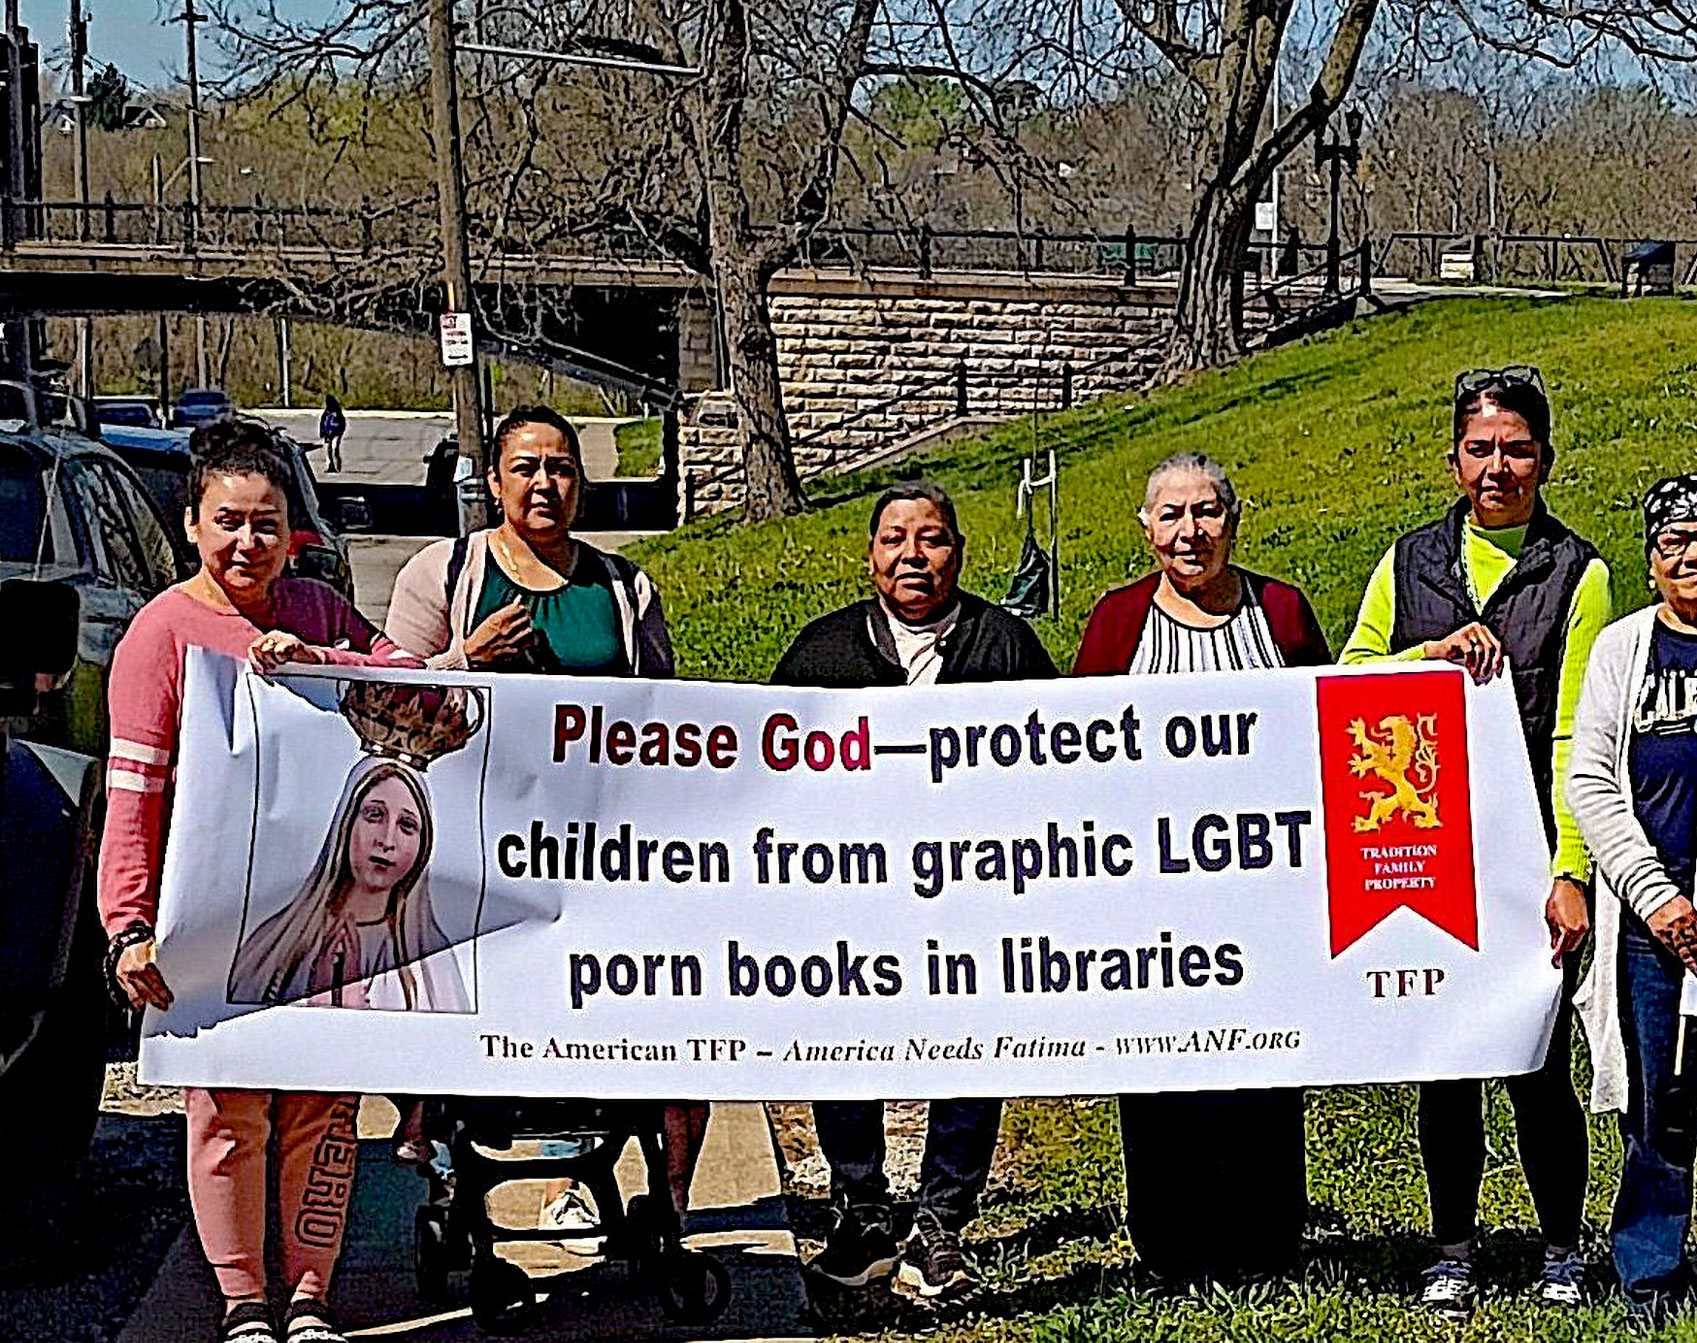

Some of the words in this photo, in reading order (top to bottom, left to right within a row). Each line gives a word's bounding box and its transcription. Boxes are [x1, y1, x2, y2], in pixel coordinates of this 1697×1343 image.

[553, 704, 737, 768] Please
[1166, 713, 1257, 758] our
[498, 821, 729, 883] children
[753, 827, 887, 883] from
[912, 821, 1132, 898] graphic
[1158, 811, 1311, 873] LGBT
[1360, 844, 1437, 859] TRADITION
[1374, 861, 1426, 875] FAMILY
[1364, 876, 1436, 891] PROPERTY
[570, 954, 701, 1009] porn
[729, 941, 902, 997] books
[927, 939, 976, 995] in
[1002, 932, 1243, 993] libraries
[1367, 969, 1444, 997] TFP
[480, 1035, 533, 1058] The
[543, 1038, 676, 1061] American
[687, 1040, 745, 1061] TFP
[783, 1040, 894, 1061] America
[905, 1037, 983, 1060] Needs
[994, 1037, 1085, 1057] Fatima
